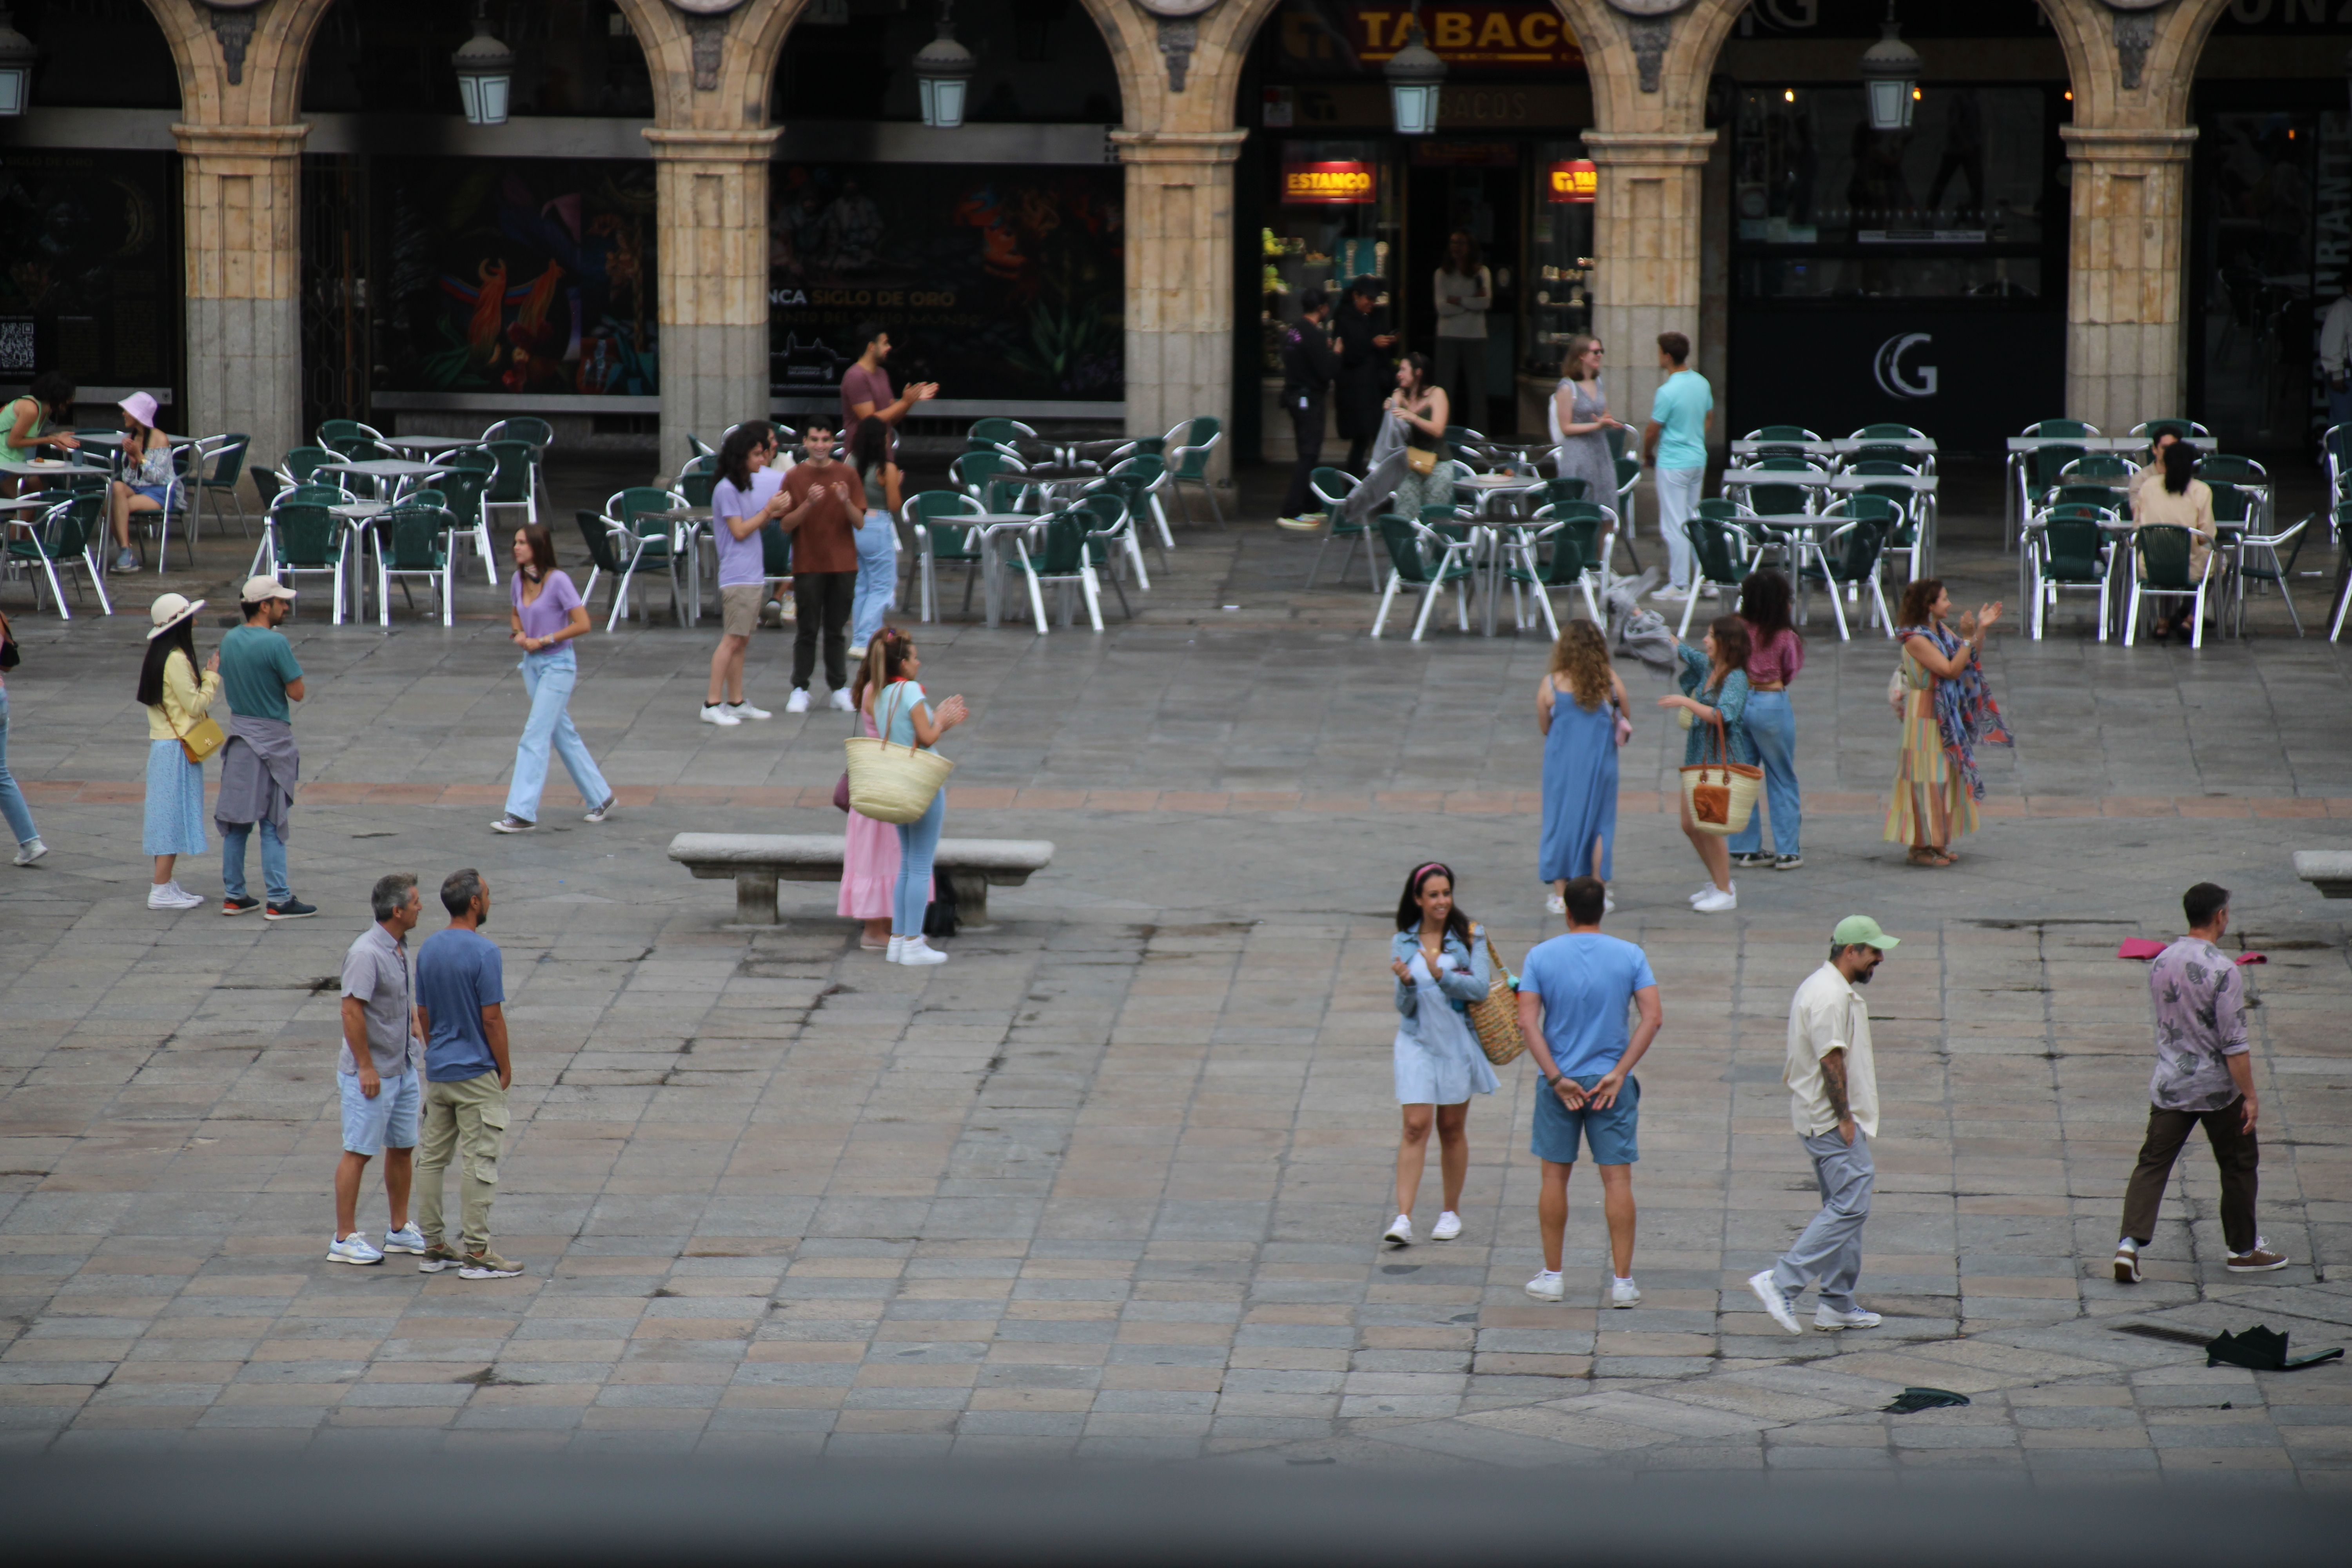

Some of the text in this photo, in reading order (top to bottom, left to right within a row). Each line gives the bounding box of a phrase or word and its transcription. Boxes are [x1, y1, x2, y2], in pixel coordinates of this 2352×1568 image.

[1287, 172, 1371, 189] ESTANCO
[811, 290, 871, 307] SIGLO
[877, 291, 904, 307] DE
[910, 291, 956, 308] ORO
[1873, 332, 1938, 401] G
